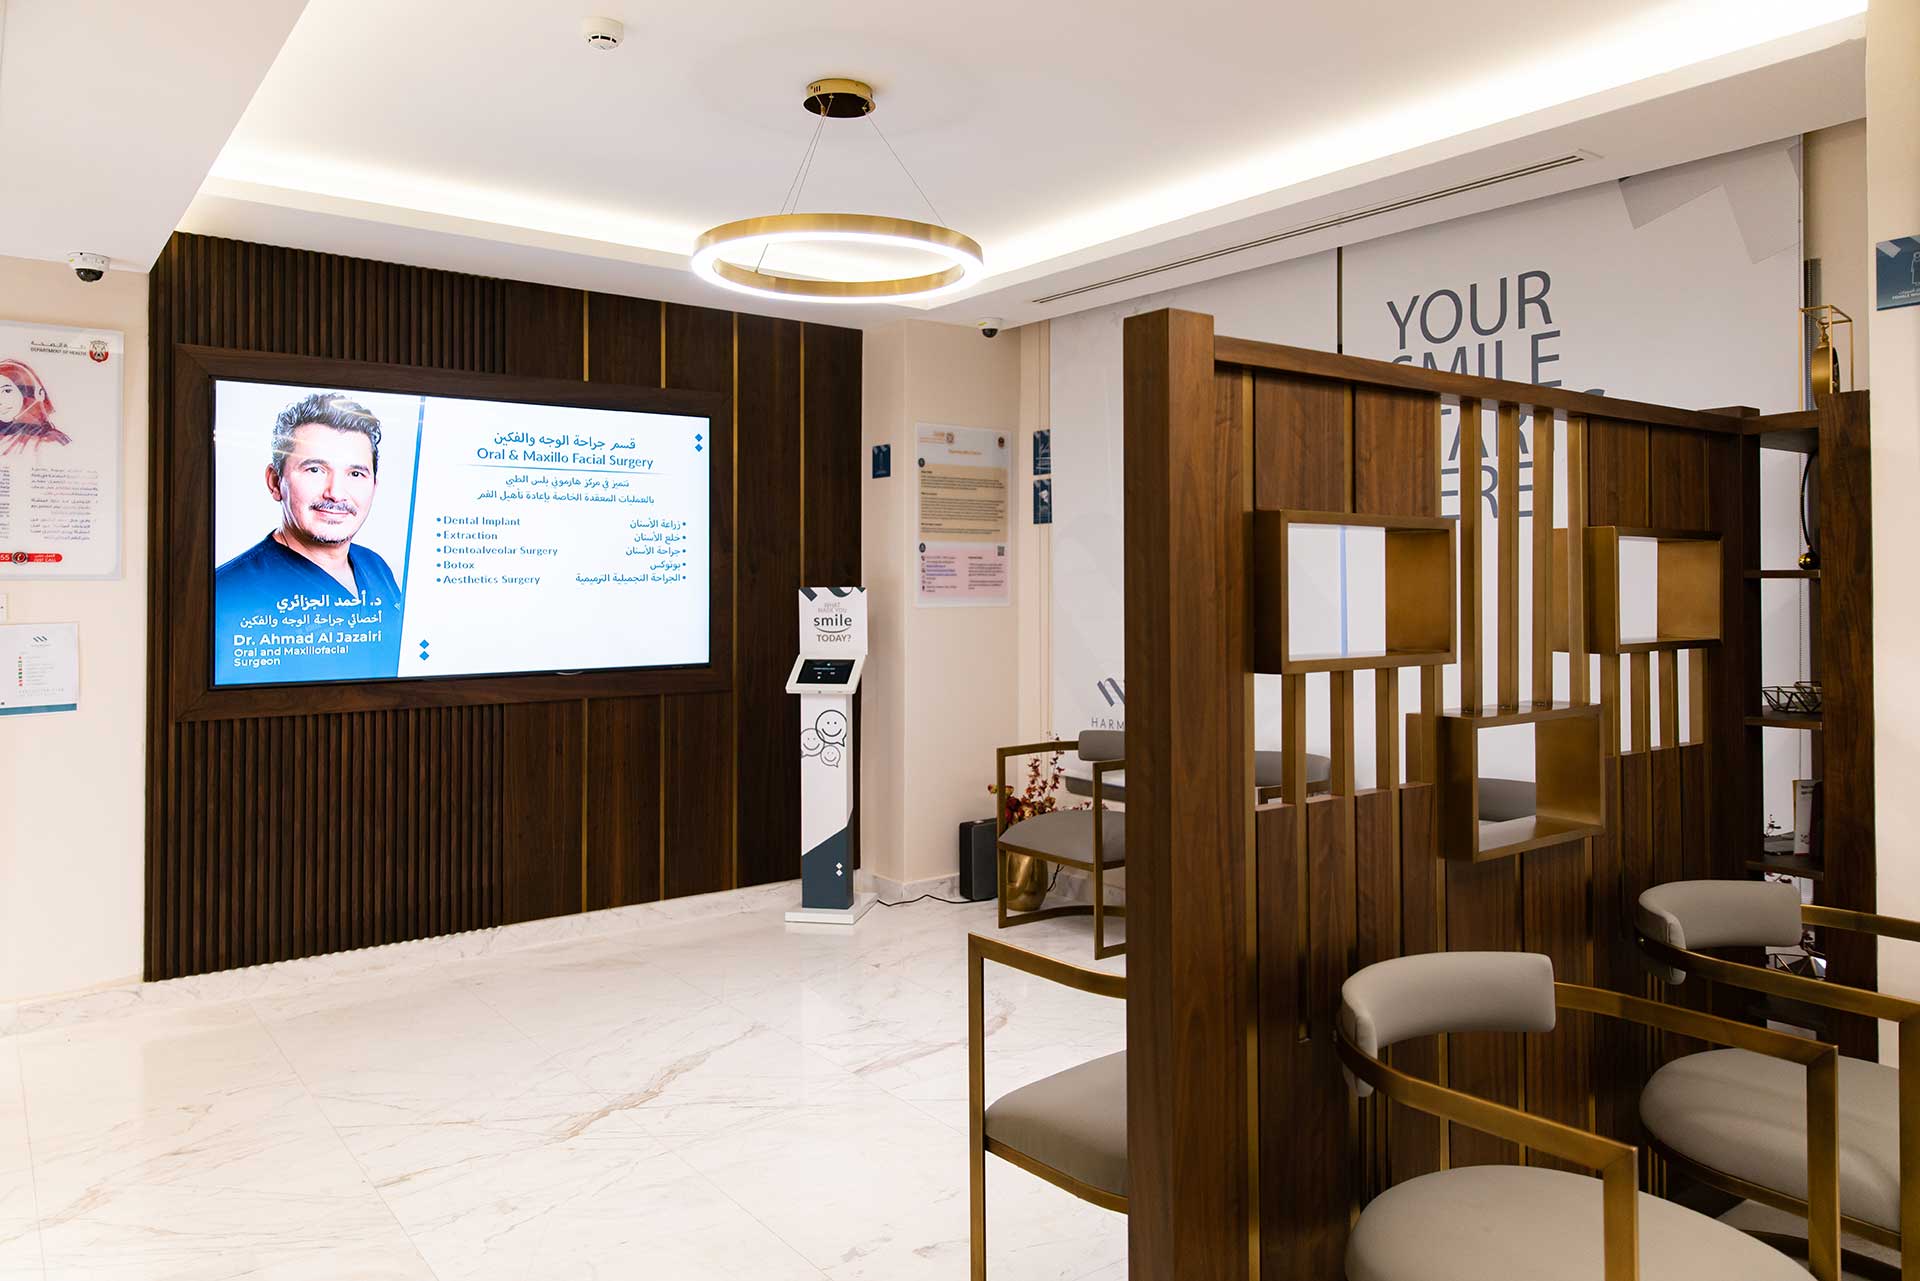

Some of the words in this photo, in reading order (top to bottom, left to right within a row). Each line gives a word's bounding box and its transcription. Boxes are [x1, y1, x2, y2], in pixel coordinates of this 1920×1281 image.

[1386, 270, 1552, 350] YOUR
[494, 432, 535, 446] والفكين
[539, 435, 569, 448] الوجه
[573, 434, 606, 450] جراحة
[610, 438, 636, 450] قسم
[477, 448, 505, 460] Oral
[509, 450, 519, 460] &
[523, 450, 569, 463] Maxillo
[573, 453, 606, 465] Facial
[609, 455, 654, 470] Surgery
[506, 475, 529, 487] الطبي
[531, 476, 549, 486] بلس
[584, 478, 600, 488] مركز
[602, 478, 609, 491] في
[477, 490, 497, 500] الفم
[553, 492, 582, 502] الخاصة
[443, 516, 478, 525] Dental
[482, 516, 521, 527] Implant
[630, 517, 659, 529] الأسنان
[660, 519, 681, 530] زراعة
[443, 530, 498, 540] Extraction
[634, 531, 662, 543] الأسنان
[665, 533, 680, 545] خلع
[443, 545, 516, 554] Dentoalveolar
[520, 546, 558, 556] Surgery
[625, 544, 654, 556] الأسنان
[657, 545, 680, 557] جراحة
[443, 560, 474, 569] Botox
[443, 575, 498, 584] Aesthetics
[501, 575, 540, 585] Surgery
[651, 573, 681, 584] الجراحة
[276, 594, 330, 613] الجزائري
[334, 589, 366, 607] أحمد
[240, 614, 278, 628] والفكين
[282, 614, 310, 627] الوجه
[314, 614, 344, 626] جراحة
[347, 610, 382, 628] أخصائي
[814, 614, 852, 626] smile
[233, 634, 256, 646] Dr.
[259, 633, 314, 645] Ahmad
[318, 632, 333, 643] Al
[336, 631, 382, 643] Jazairi
[816, 634, 852, 642] TODAY?
[234, 647, 257, 657] Oral
[260, 647, 281, 656] and
[283, 645, 349, 656] Maxillofacial
[234, 658, 281, 668] Surgeon
[1091, 717, 1125, 729] HARM
